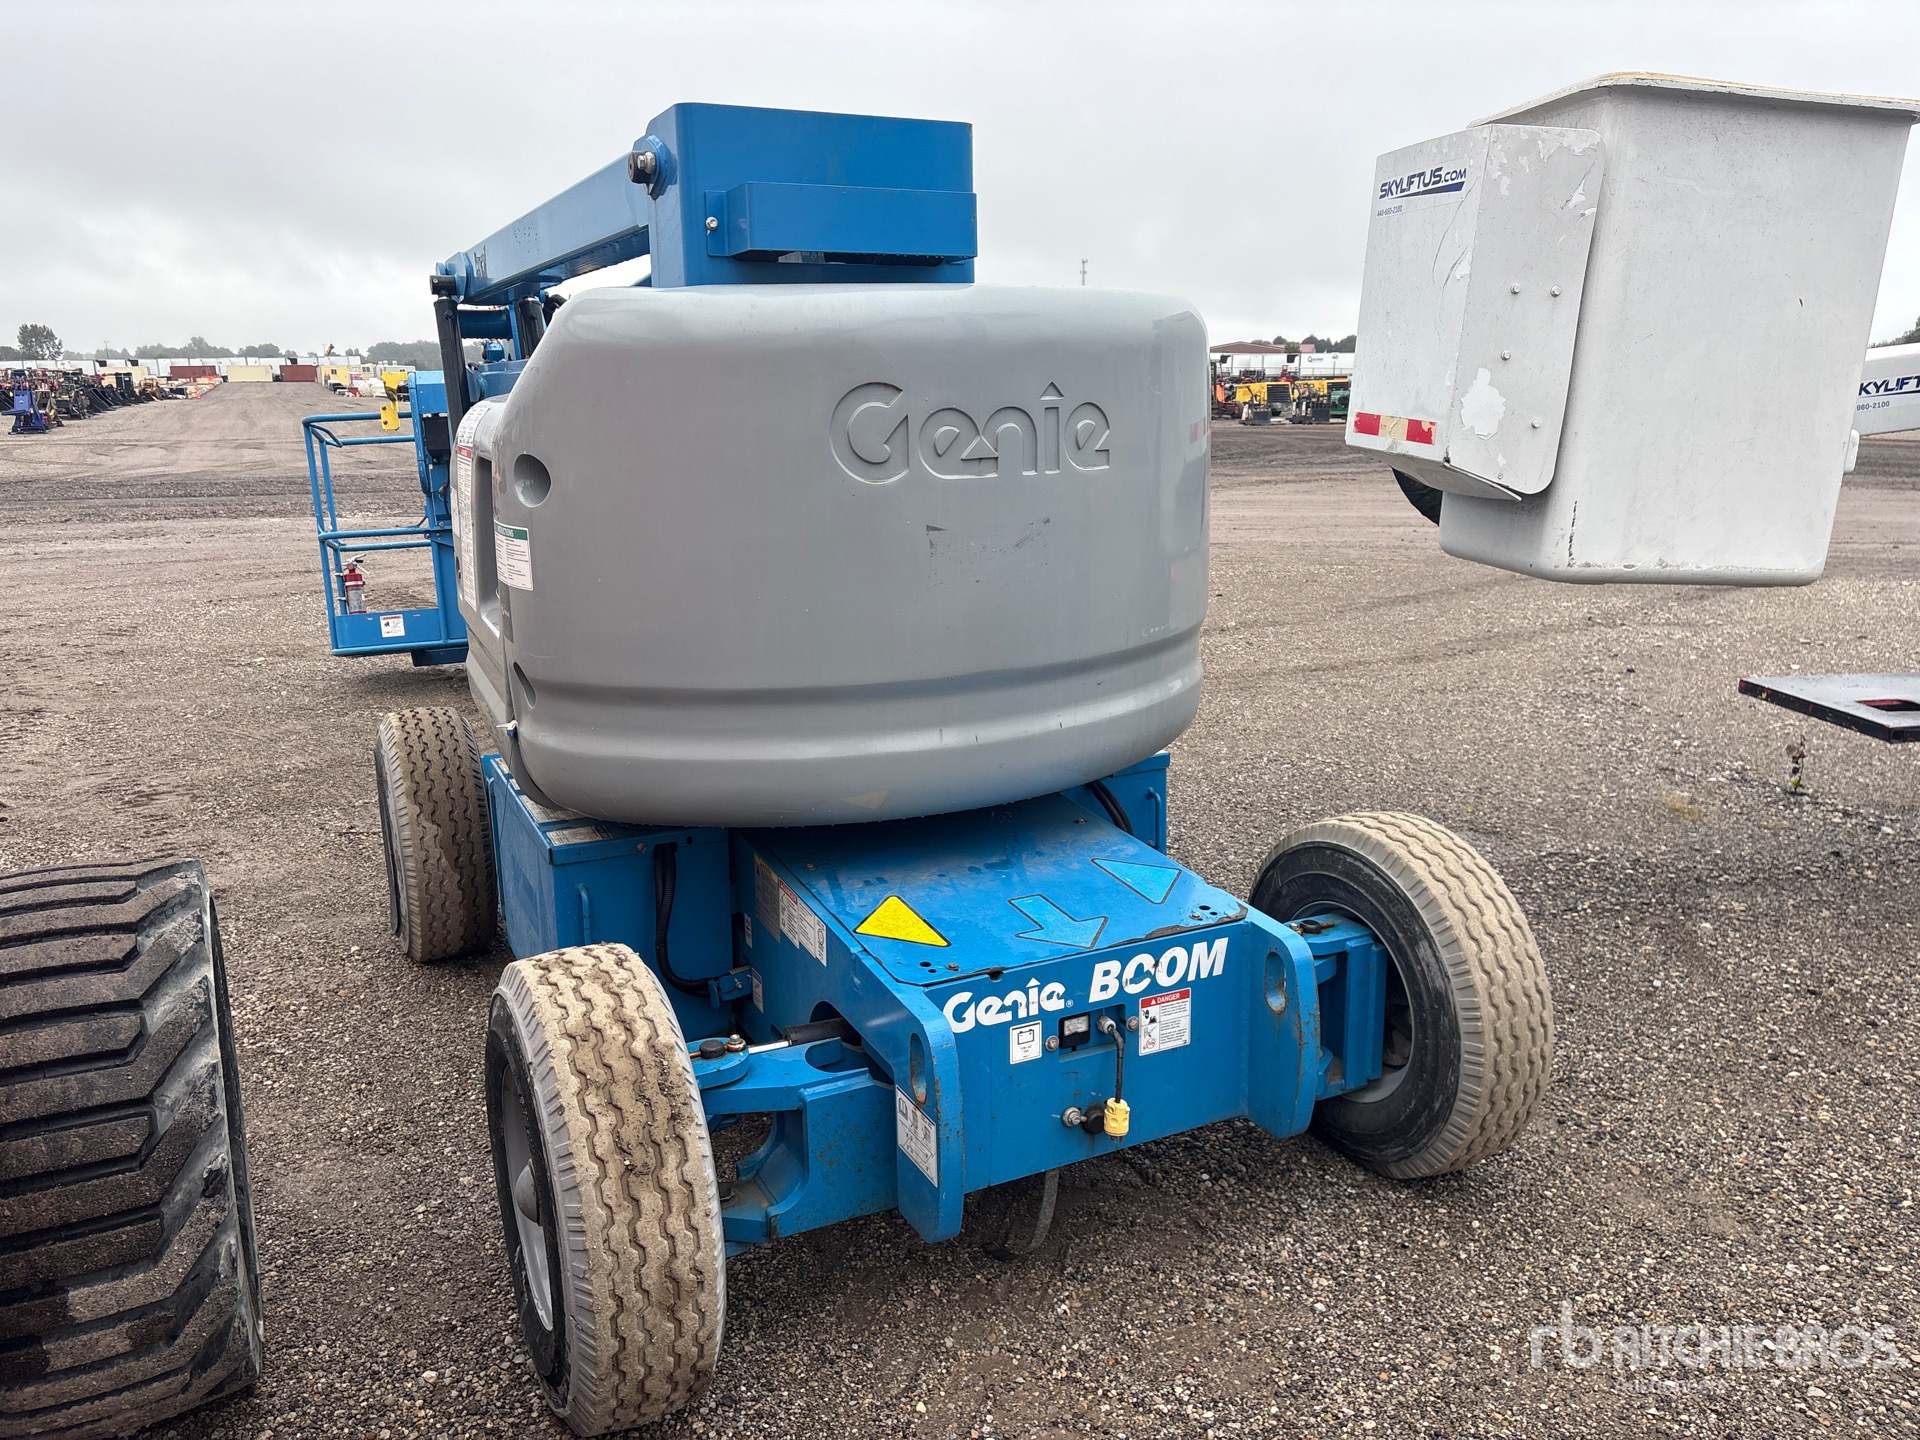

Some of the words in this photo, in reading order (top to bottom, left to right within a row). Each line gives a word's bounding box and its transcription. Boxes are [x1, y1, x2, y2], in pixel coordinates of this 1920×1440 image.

[1379, 166, 1467, 200] SKYLIFTUS.COM
[829, 381, 1111, 484] Genie
[1089, 937, 1229, 1003] BOOM
[1157, 993, 1180, 1004] DANGER
